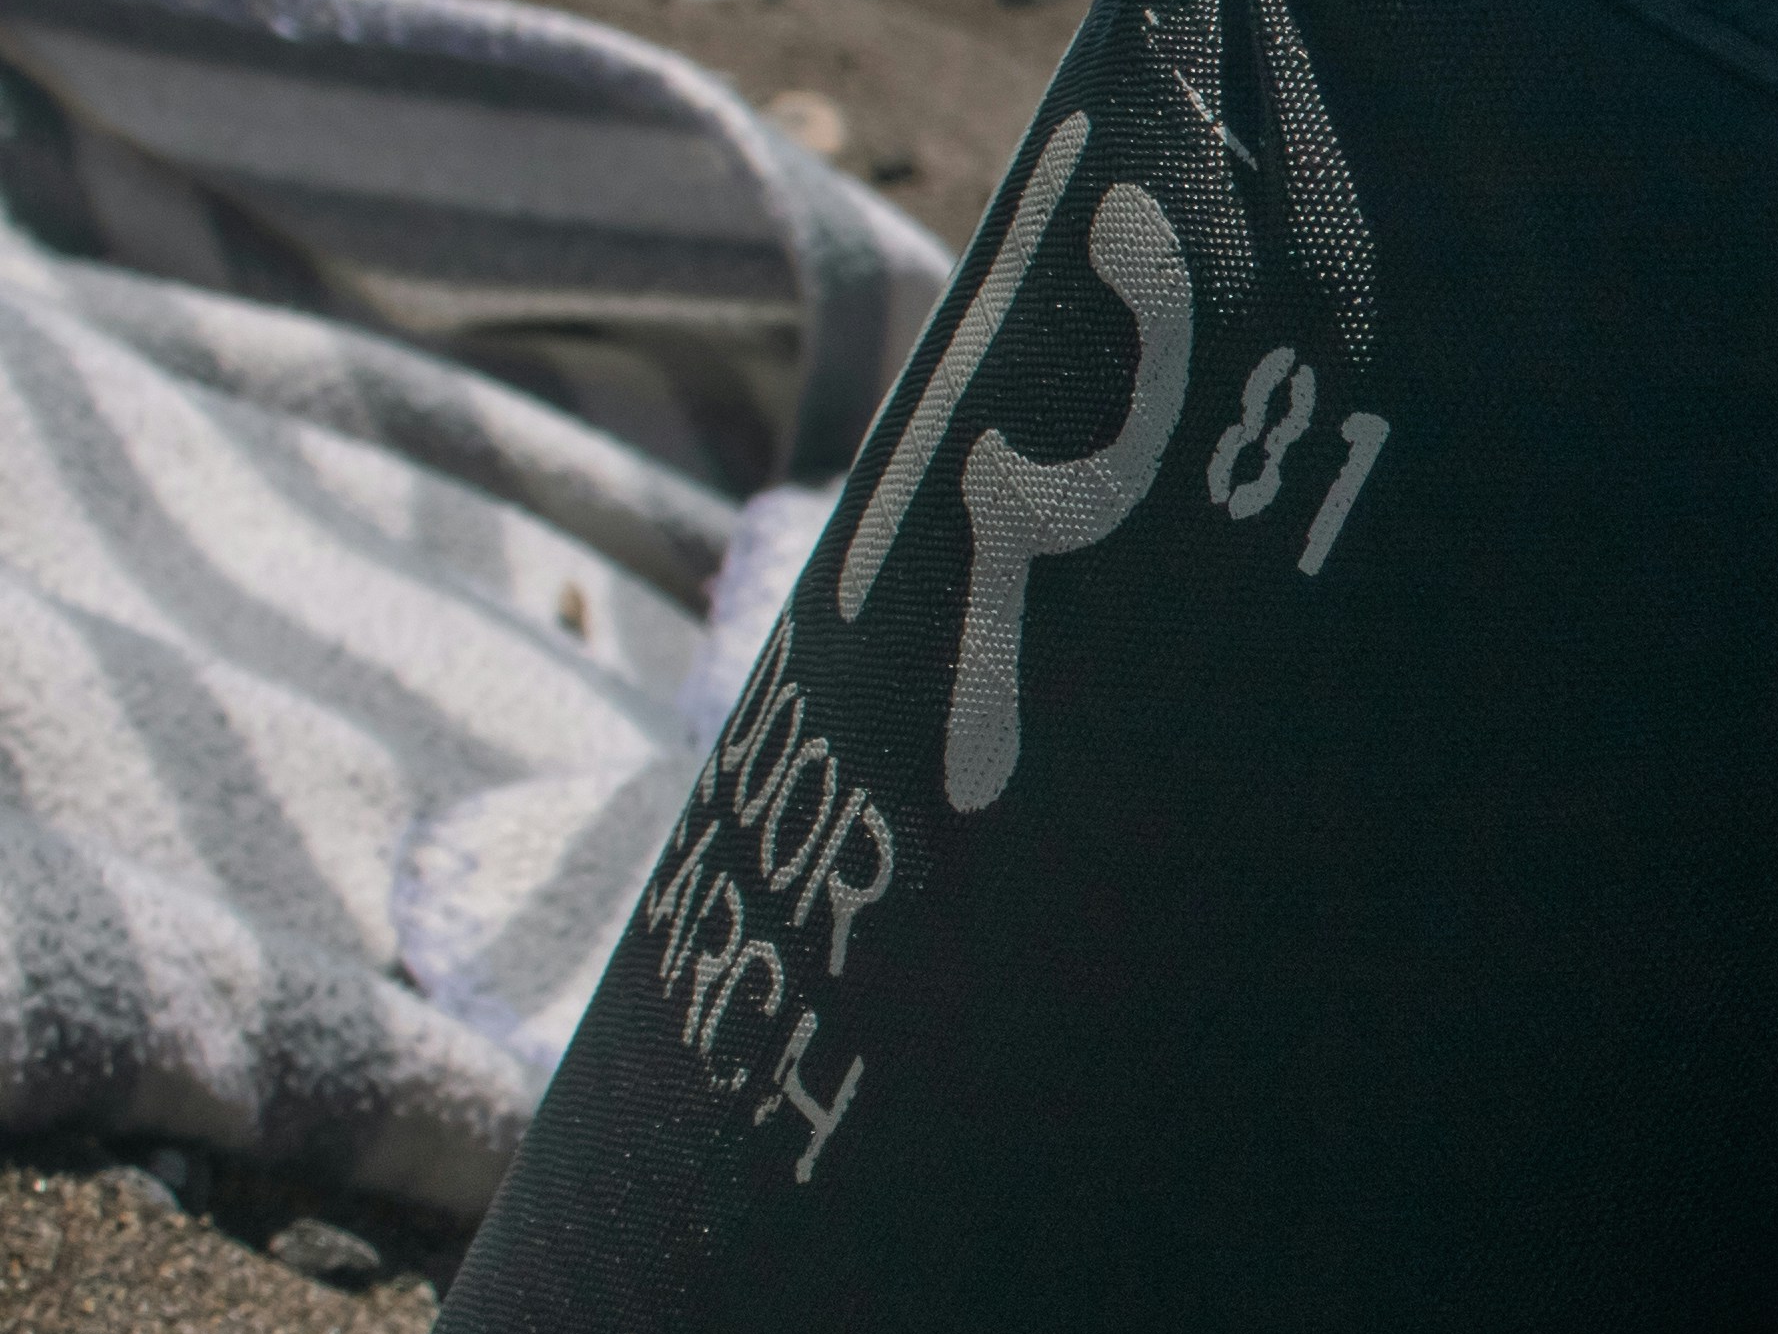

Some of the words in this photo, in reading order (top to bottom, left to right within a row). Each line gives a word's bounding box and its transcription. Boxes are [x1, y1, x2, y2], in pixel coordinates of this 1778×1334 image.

[1207, 345, 1391, 577] 81
[648, 752, 866, 1184] ARCH
[722, 609, 896, 977] DOOR
